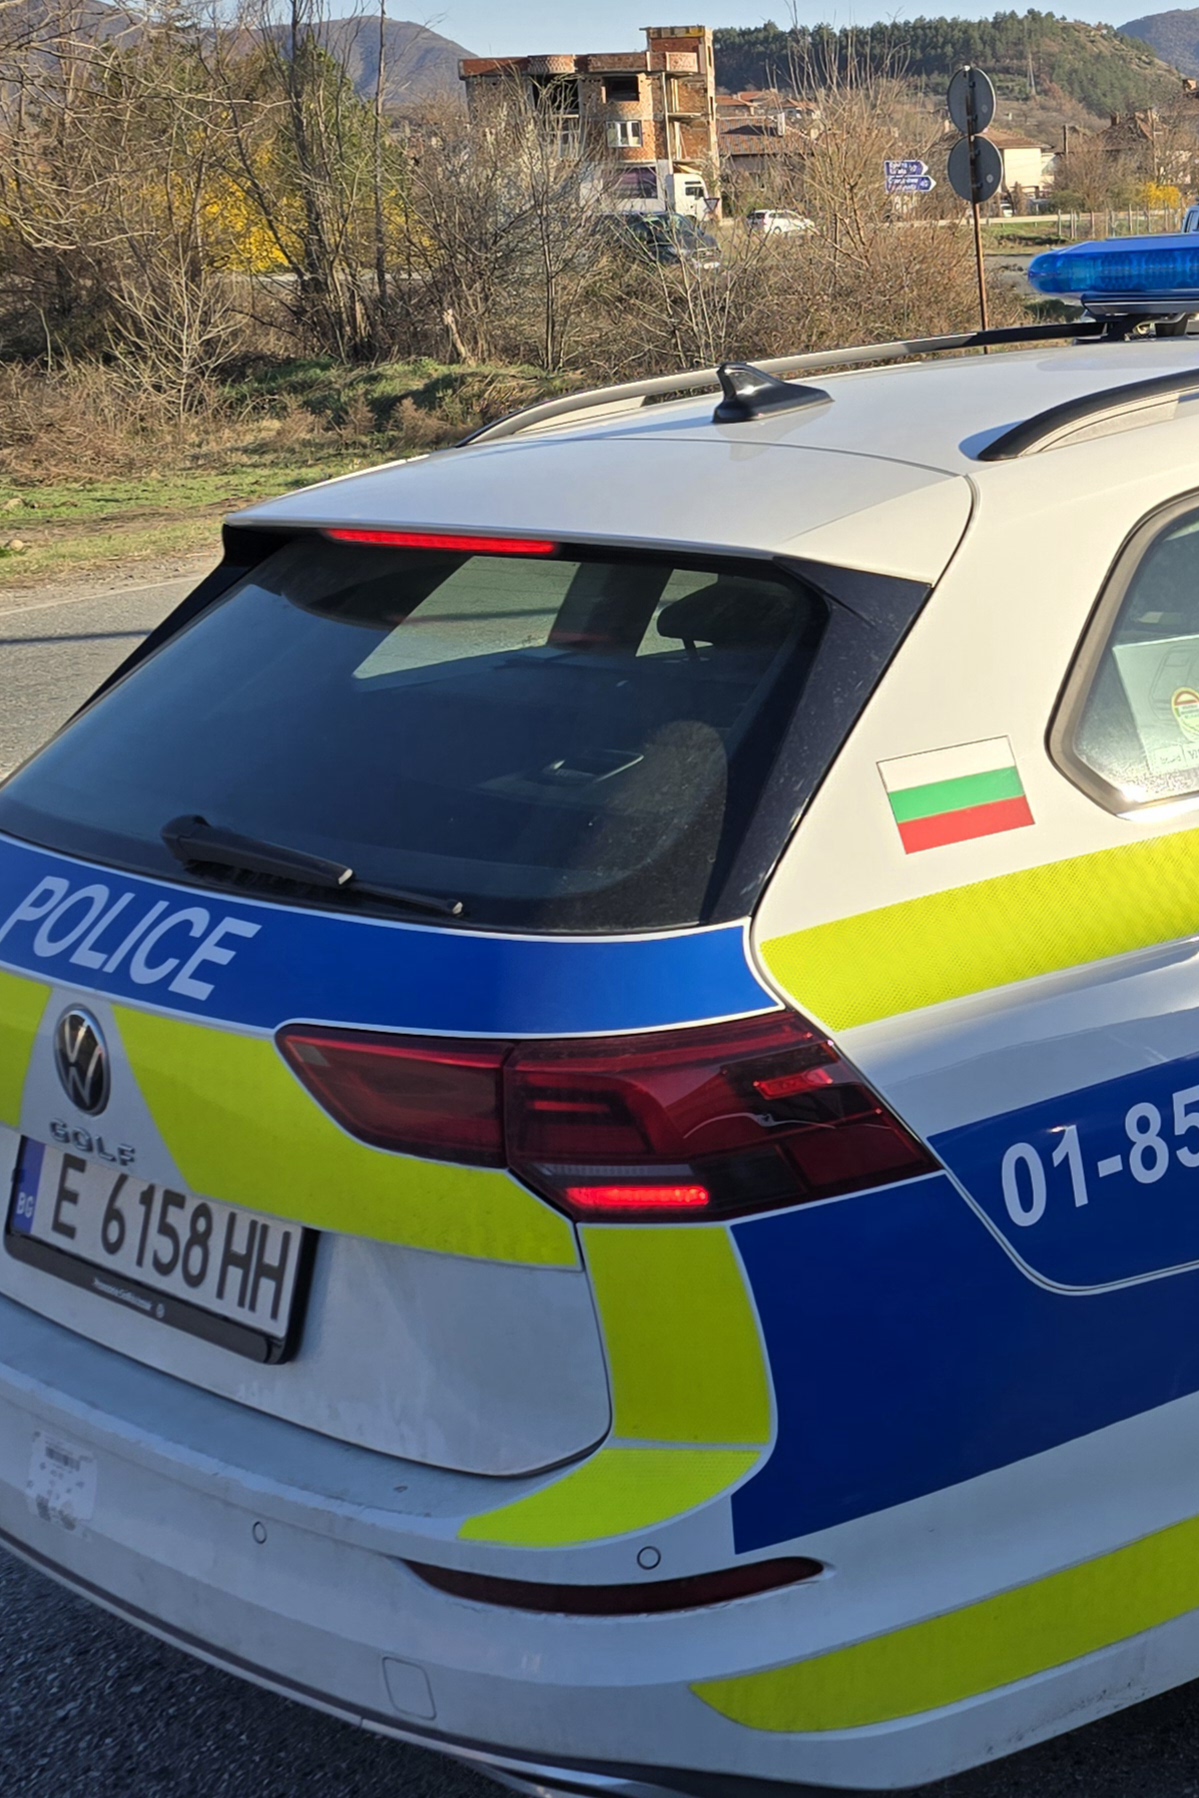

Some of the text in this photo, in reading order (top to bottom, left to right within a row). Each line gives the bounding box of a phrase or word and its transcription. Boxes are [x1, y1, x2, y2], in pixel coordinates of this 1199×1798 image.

[0, 876, 262, 1001] POLICE
[50, 1117, 135, 1167] GOLF
[16, 1191, 34, 1218] BG
[51, 1152, 292, 1322] E 6158 HH
